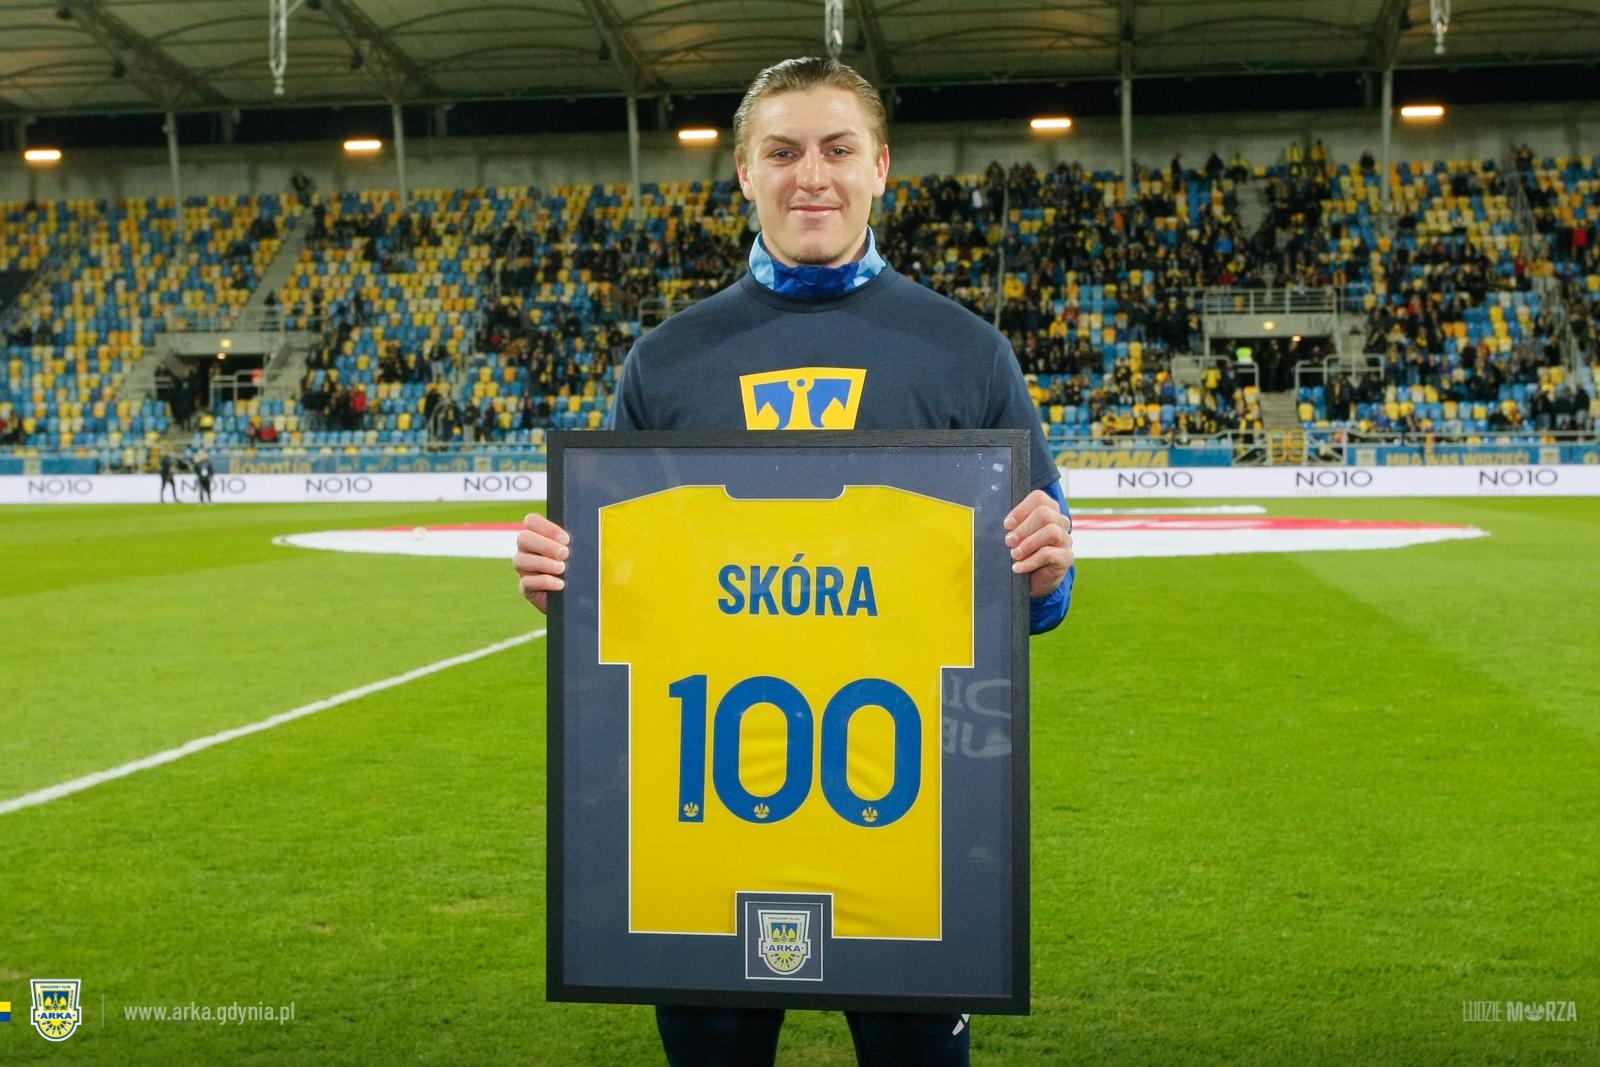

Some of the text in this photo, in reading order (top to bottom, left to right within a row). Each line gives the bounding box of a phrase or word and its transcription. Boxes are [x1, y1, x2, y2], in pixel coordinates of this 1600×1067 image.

[1055, 450, 1169, 468] GDYNIA
[717, 553, 879, 617] SKÓRA
[668, 674, 922, 828] 100
[768, 944, 801, 952] ARKA
